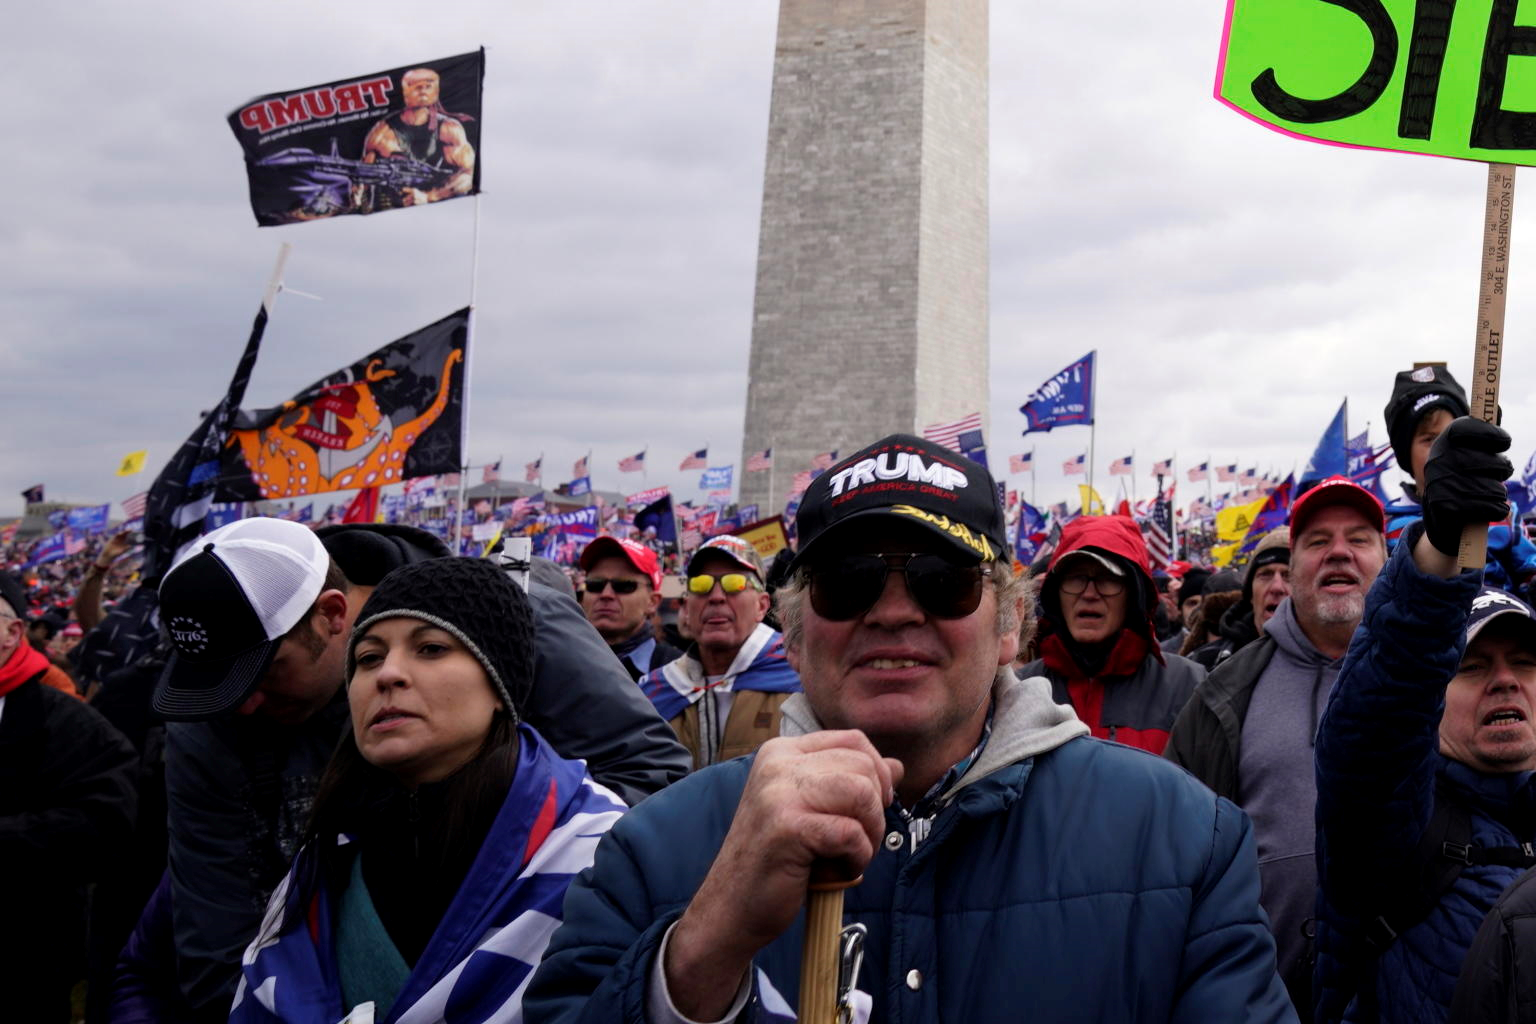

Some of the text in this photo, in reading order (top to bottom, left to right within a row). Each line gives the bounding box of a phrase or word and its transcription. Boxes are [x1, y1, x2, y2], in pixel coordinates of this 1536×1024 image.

[1496, 191, 1511, 262] WASHINGTON
[1494, 275, 1505, 294] 304
[1487, 329, 1500, 383] OUTLET
[829, 452, 968, 498] TRUMP
[862, 482, 916, 495] AMERICA
[919, 485, 960, 502] GREAT
